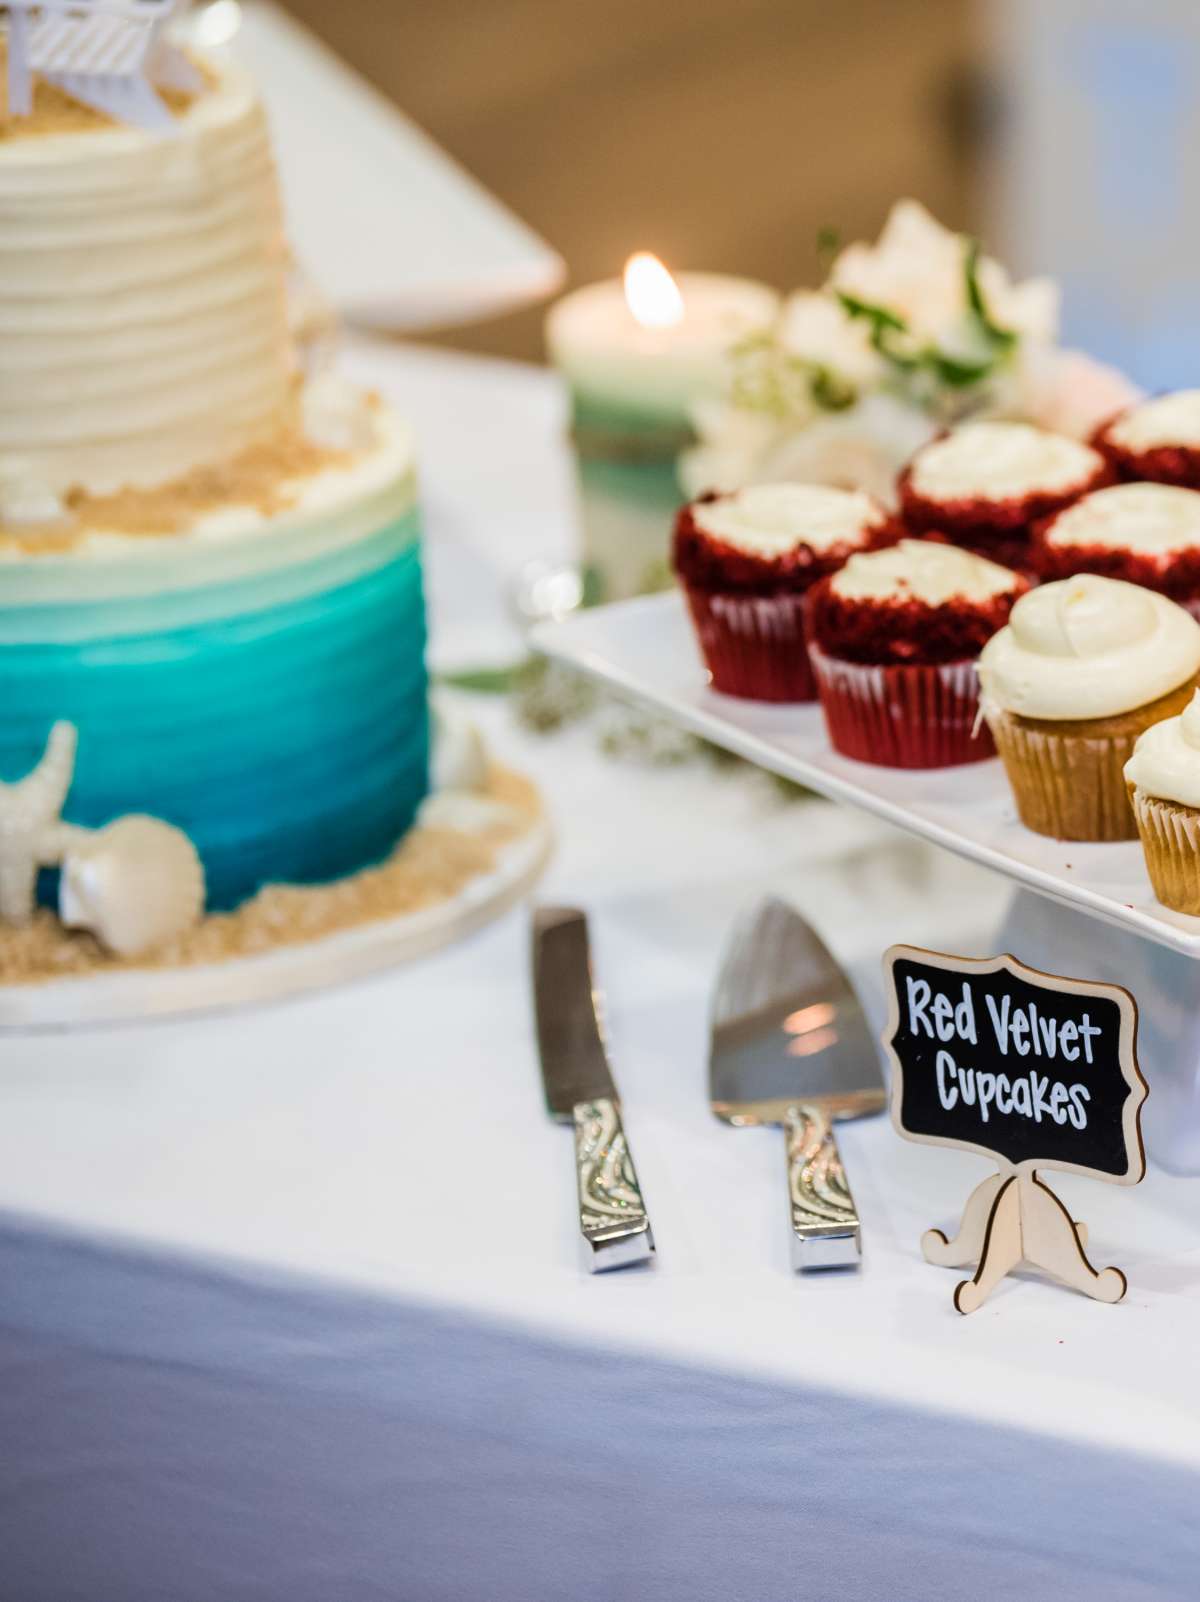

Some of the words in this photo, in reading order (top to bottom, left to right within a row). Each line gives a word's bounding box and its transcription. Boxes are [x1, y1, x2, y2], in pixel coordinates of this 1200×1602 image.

[906, 975, 978, 1046] Red
[985, 994, 1102, 1064] Velvet
[935, 1050, 1091, 1130] Cupcakes
